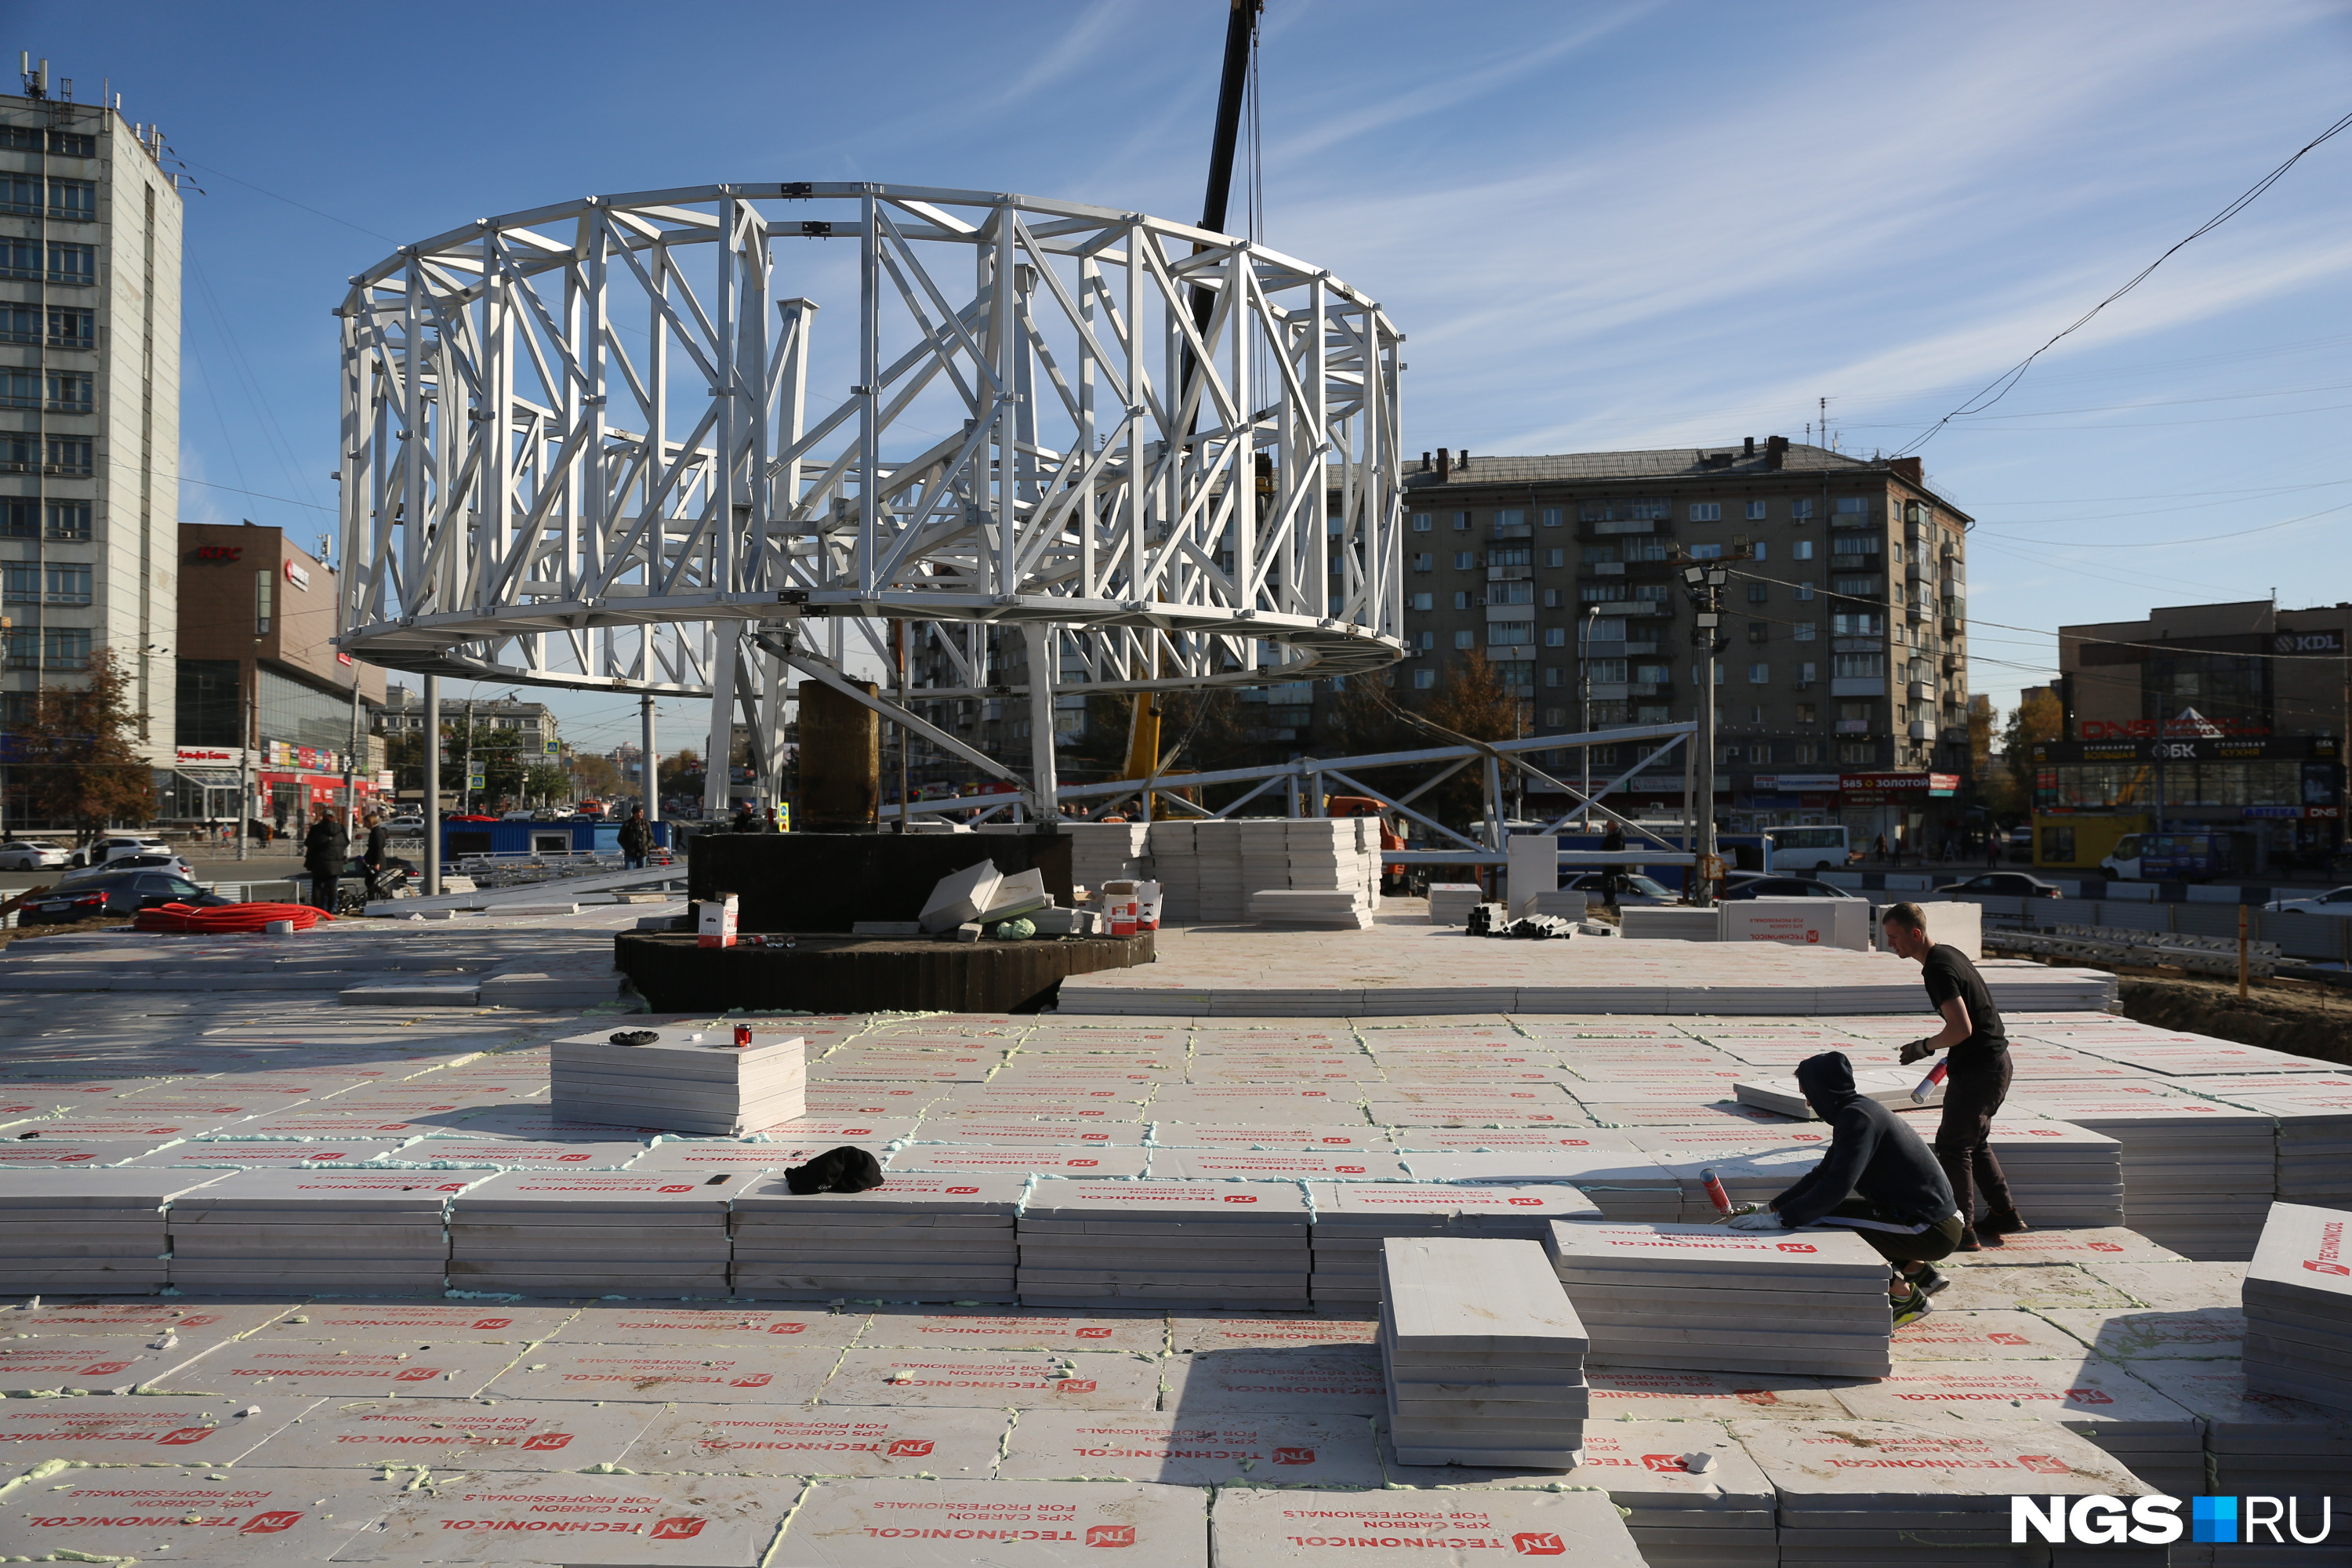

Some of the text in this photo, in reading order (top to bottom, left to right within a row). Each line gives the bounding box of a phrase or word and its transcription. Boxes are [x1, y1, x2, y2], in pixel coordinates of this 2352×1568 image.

[198, 546, 243, 560] KFC
[2296, 634, 2340, 651] KDL
[2082, 719, 2158, 739] DNS
[2220, 748, 2259, 757] КУХНЯ
[1842, 779, 1863, 788] 585
[1876, 778, 1929, 788] ЗОЛОТОЙ
[2310, 808, 2338, 817] DNS
[2318, 1221, 2343, 1262] TECHNONICOL
[232, 1369, 391, 1377] TECHNONICOL
[947, 1369, 1015, 1377] CARBON
[887, 1379, 1050, 1389] TECHNONICOL
[1892, 1392, 2067, 1401] TECHNONICOL
[360, 1415, 537, 1424] FOR PROFESSIONALS
[712, 1421, 888, 1429] FOR PROFESSIONALS
[1076, 1428, 1257, 1437] FOR PROFESSIONALS
[698, 1440, 882, 1452] TECHNONICOL
[1073, 1448, 1264, 1460] TECHNONICOL
[1824, 1459, 2020, 1468] TECHNONICOL
[68, 1490, 273, 1498] FOR PROFESSIONALS
[463, 1494, 662, 1504] FOR PROFESSIONALS
[529, 1504, 655, 1514] XPS CARBON
[873, 1501, 1076, 1512] FOR PROFESSIONALS
[947, 1512, 1074, 1522] XPS CARBON
[1283, 1511, 1488, 1519] FOR PROFESSIONALS
[441, 1519, 643, 1533] TECHNONICOL
[1363, 1521, 1491, 1530] XPS CARBON
[864, 1527, 1077, 1541] TECHNONICOL
[1287, 1537, 1505, 1548] TECHNONICOL
